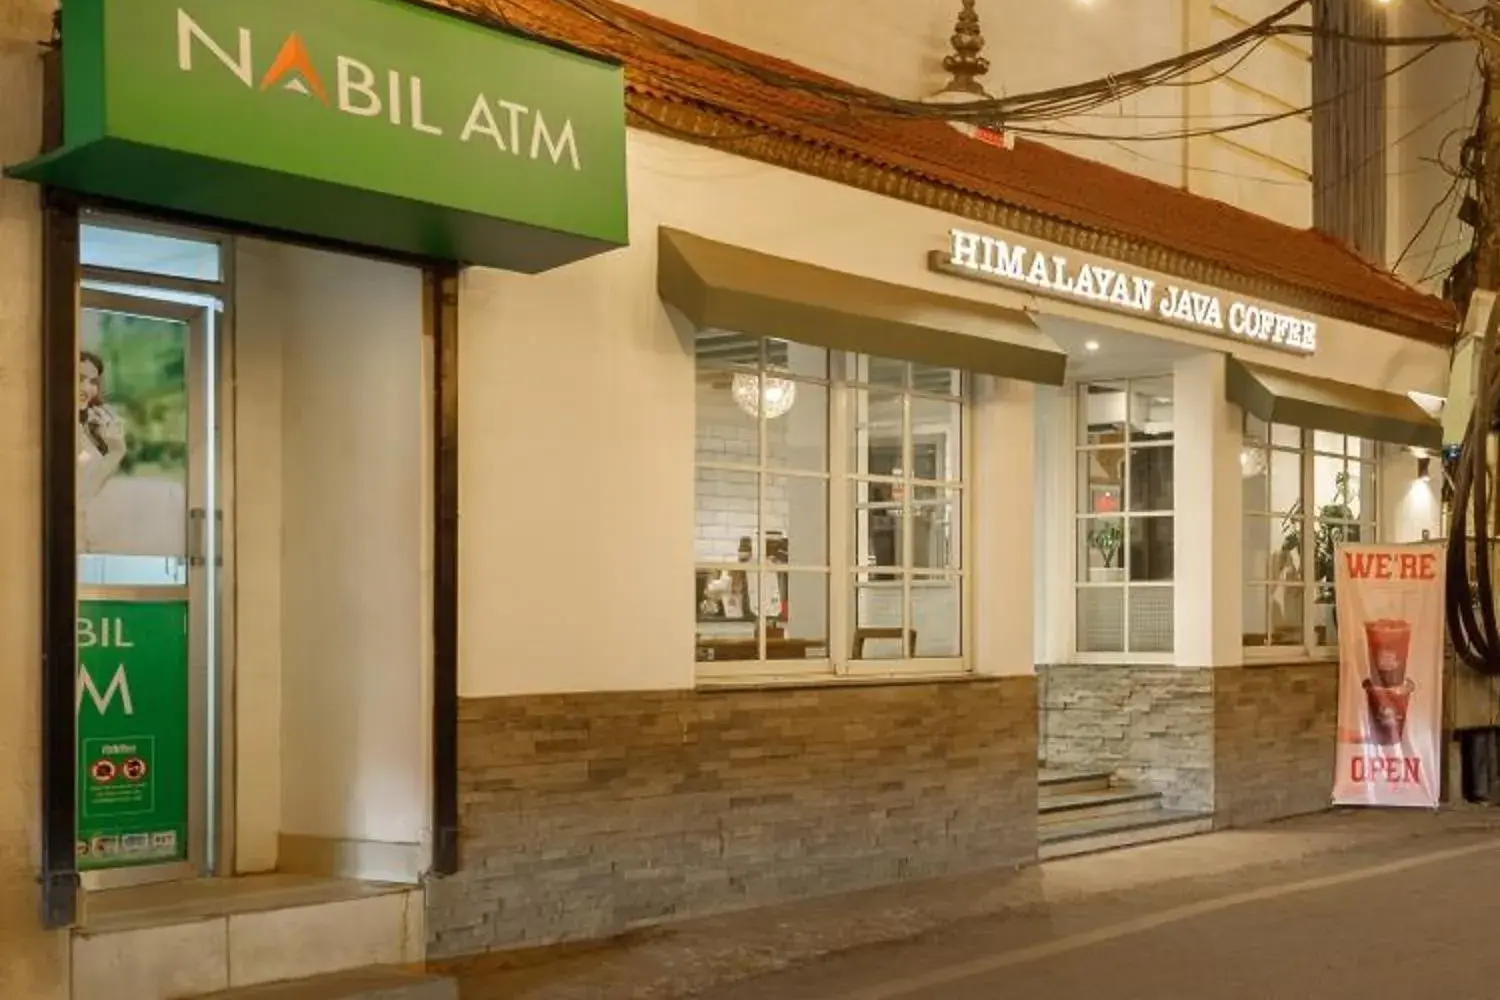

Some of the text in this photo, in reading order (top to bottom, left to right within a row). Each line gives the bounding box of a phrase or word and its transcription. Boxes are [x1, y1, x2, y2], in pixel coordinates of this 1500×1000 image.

[178, 8, 581, 170] NABIL ATM
[950, 228, 1317, 350] HIMALAYAN JAVA COFFEE
[1345, 552, 1437, 581] WE'RE
[1351, 756, 1421, 784] OPEN
